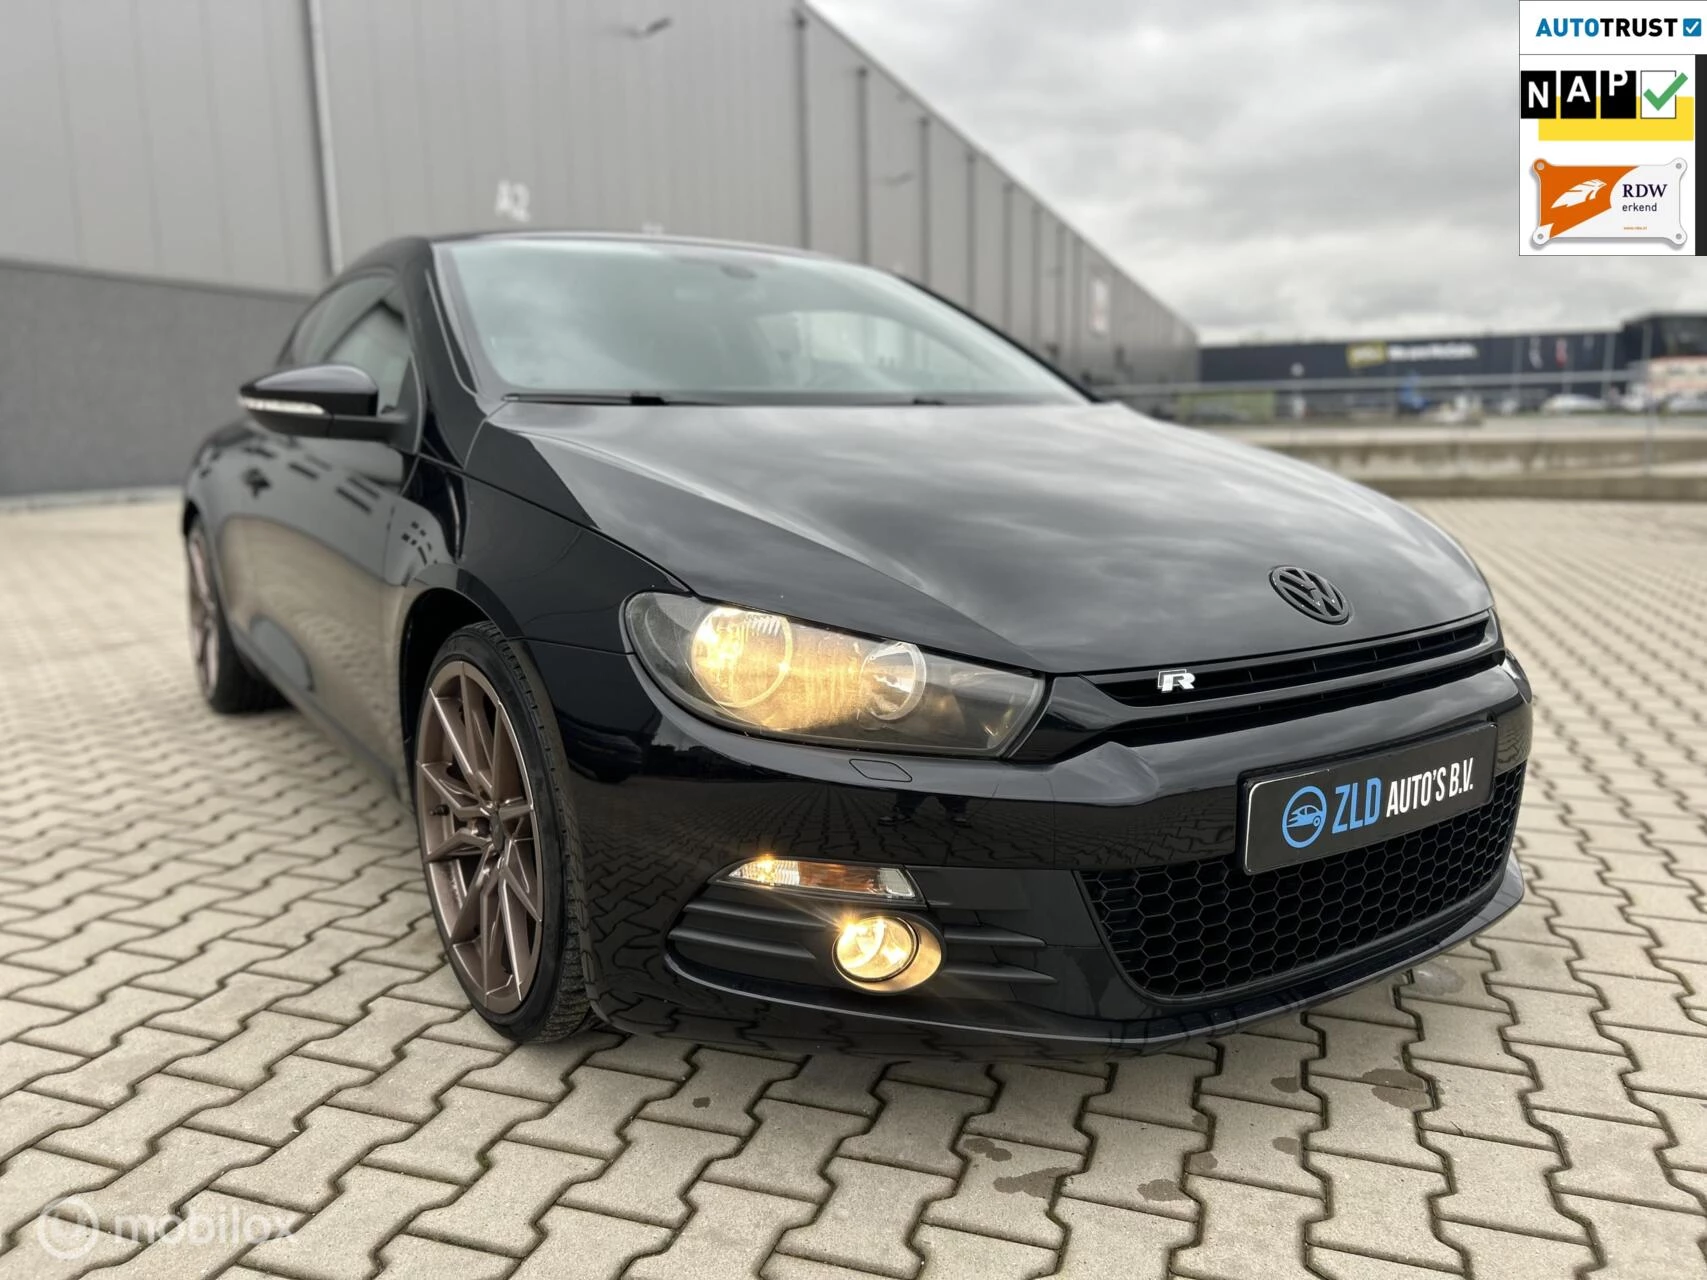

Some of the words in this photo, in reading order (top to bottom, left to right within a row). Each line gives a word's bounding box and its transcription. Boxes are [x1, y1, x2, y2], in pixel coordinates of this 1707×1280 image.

[1157, 668, 1196, 693] R
[1331, 777, 1382, 834] ZLD
[1385, 766, 1447, 818] AUTO'S
[1449, 757, 1474, 798] B.V.
